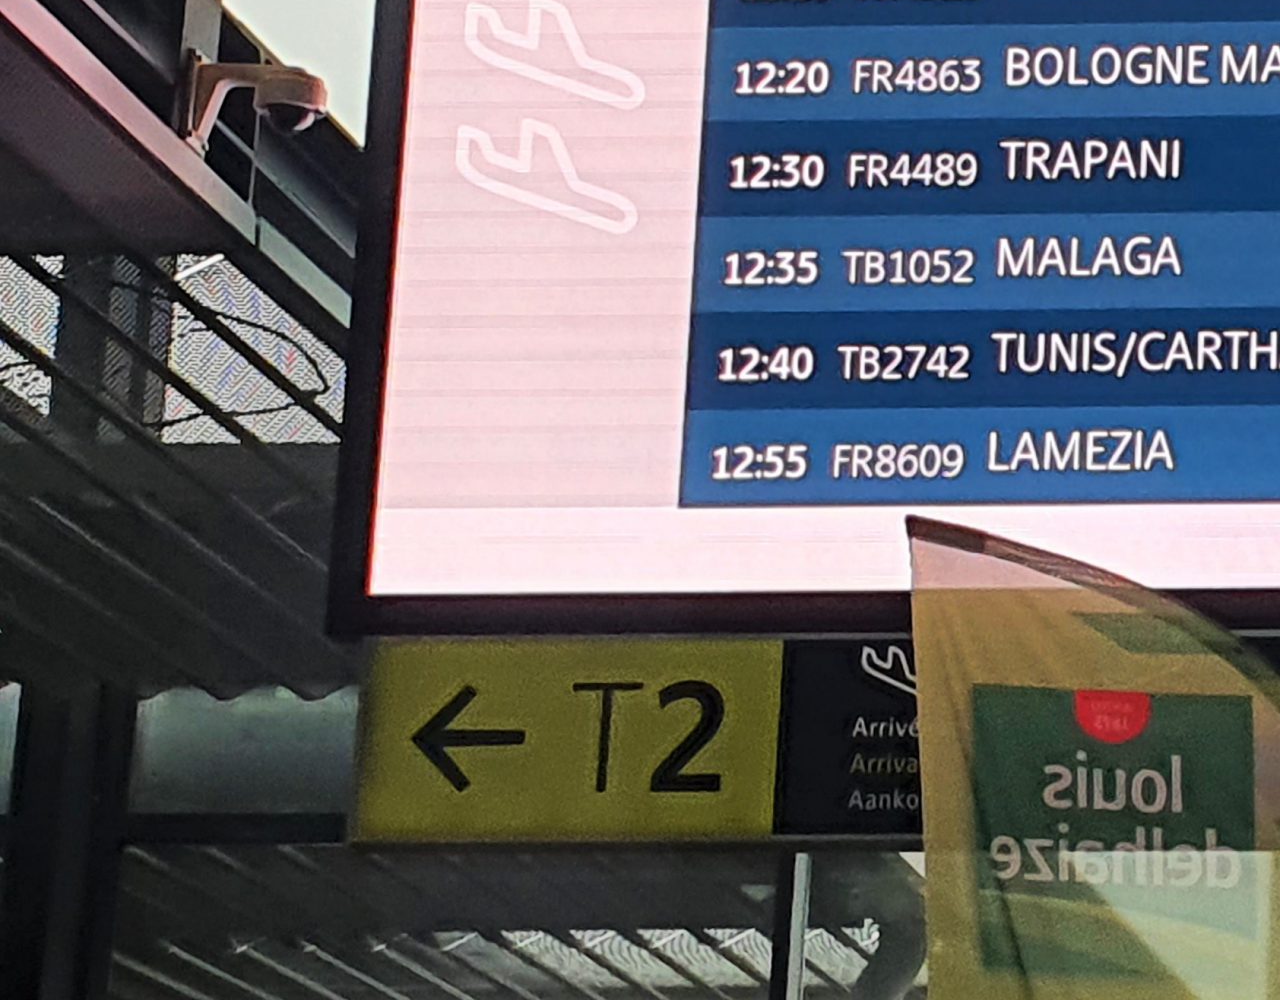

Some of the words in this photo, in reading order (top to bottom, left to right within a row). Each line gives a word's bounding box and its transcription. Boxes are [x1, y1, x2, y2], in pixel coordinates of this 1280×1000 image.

[735, 61, 830, 95] 12:20
[853, 59, 981, 94] FR4863
[1005, 45, 1210, 87] BOLOGNE
[729, 155, 825, 189] 12:30
[848, 153, 978, 188] FR4489
[999, 139, 1180, 180] TRAPANI
[724, 251, 818, 285] 12:35
[842, 249, 974, 284] TB1052
[996, 235, 1181, 277] MALAGA
[718, 347, 814, 381] 12:40
[837, 346, 970, 380] TB2742
[711, 445, 808, 480] 12:55
[832, 444, 964, 478] FR8609
[987, 429, 1174, 472] LAMEZIA
[572, 680, 725, 793] T2
